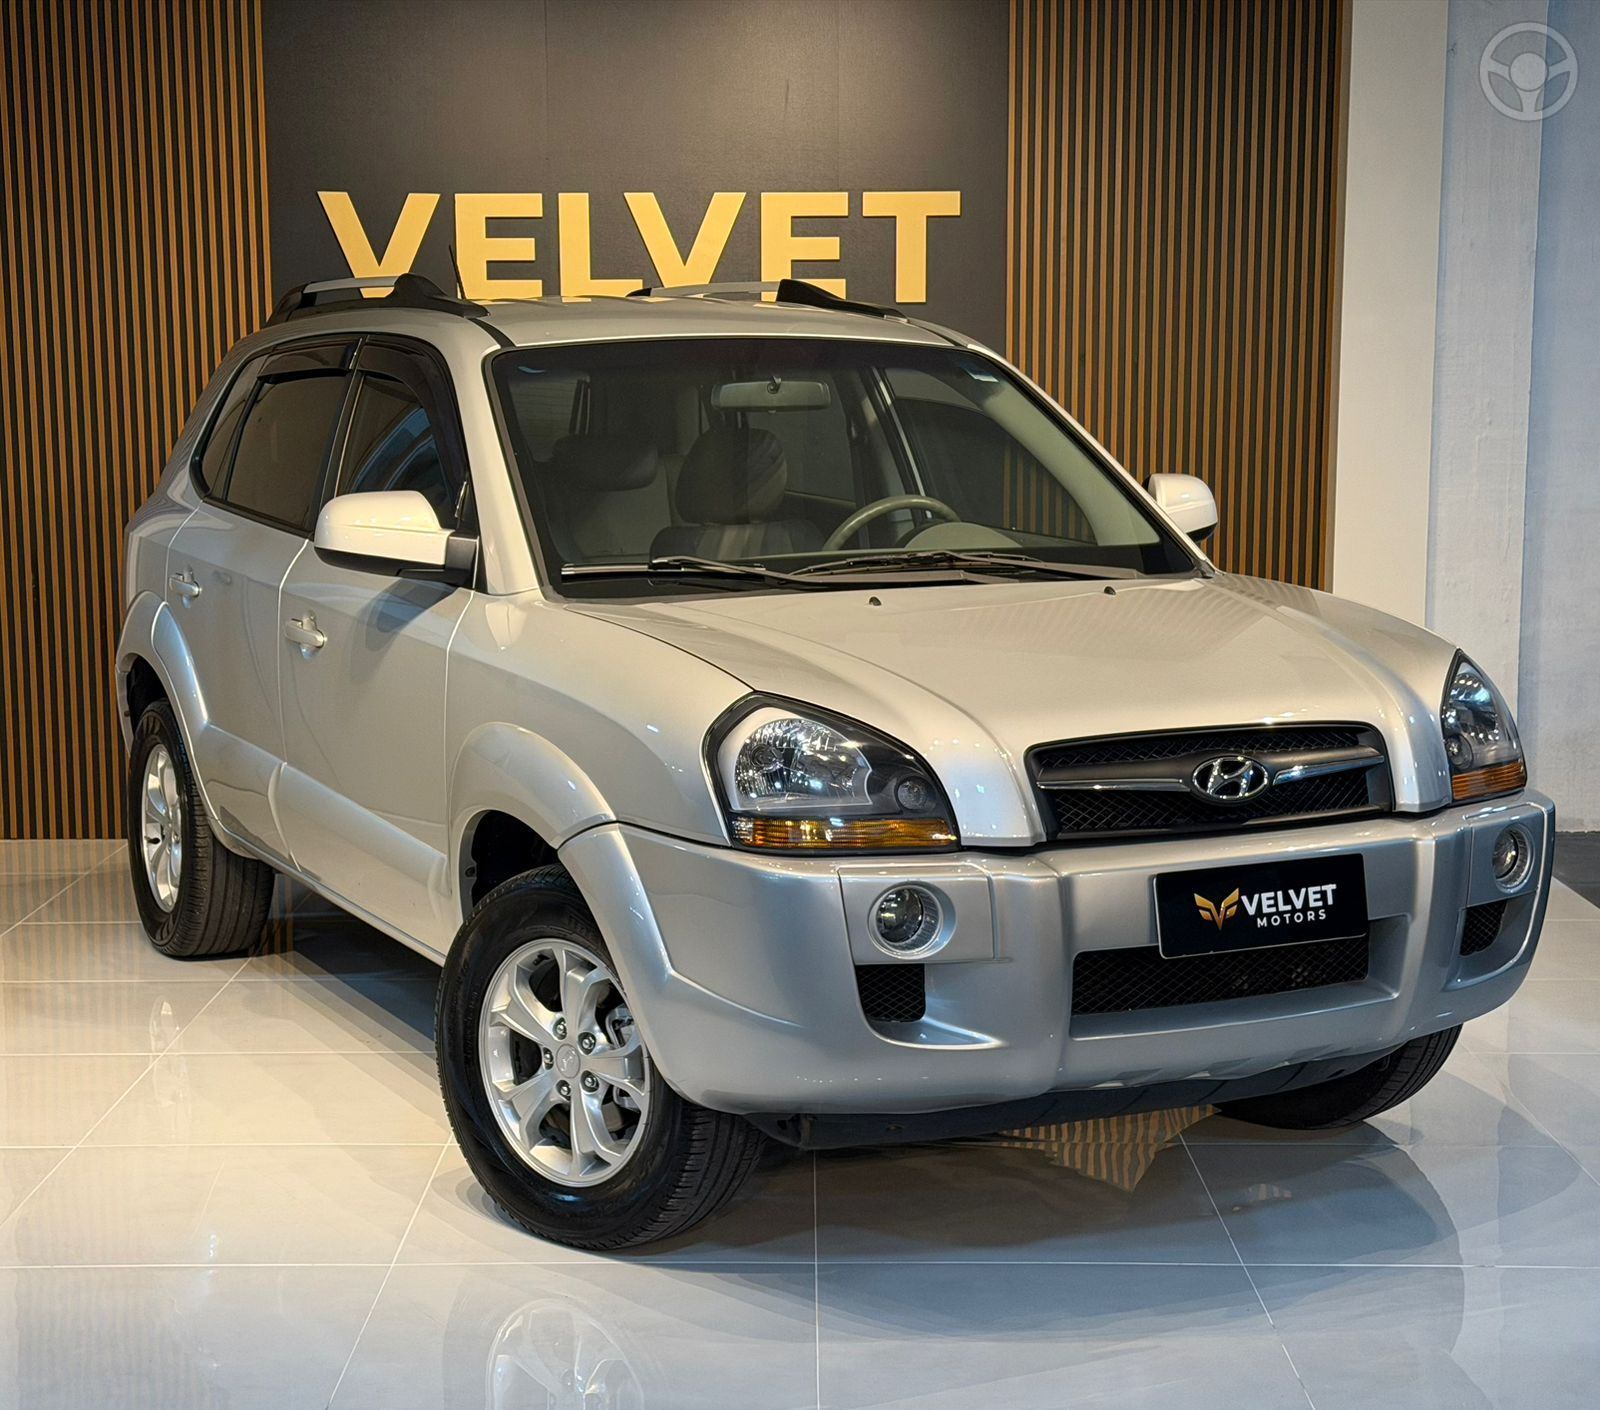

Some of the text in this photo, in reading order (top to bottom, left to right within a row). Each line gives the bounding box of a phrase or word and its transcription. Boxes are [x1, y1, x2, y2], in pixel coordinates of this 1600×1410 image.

[318, 191, 961, 303] VELVET
[1242, 884, 1337, 915] VELVET
[1257, 909, 1326, 928] MOTORS
